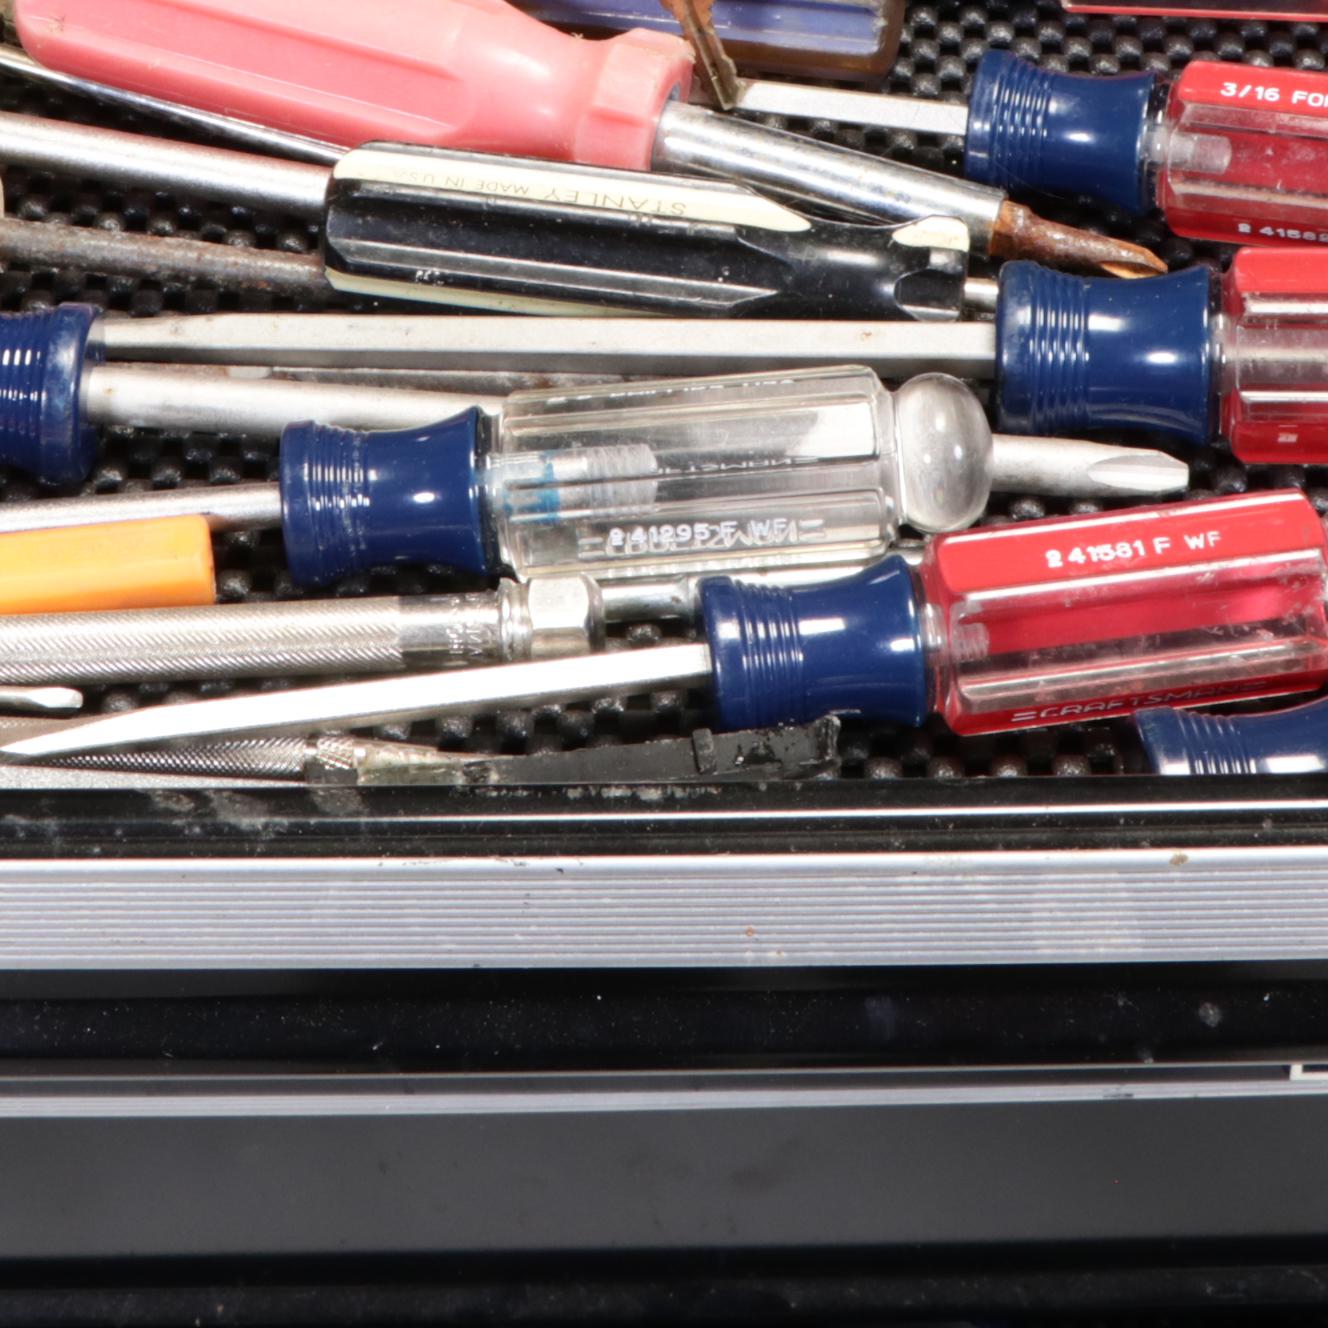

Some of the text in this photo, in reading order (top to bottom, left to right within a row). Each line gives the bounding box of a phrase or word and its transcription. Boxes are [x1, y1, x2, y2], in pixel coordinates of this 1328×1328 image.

[1219, 81, 1281, 103] 3/16
[475, 178, 530, 196] MADE
[542, 186, 687, 216] STANLEY
[1152, 536, 1172, 555] F
[1183, 530, 1221, 551] WF
